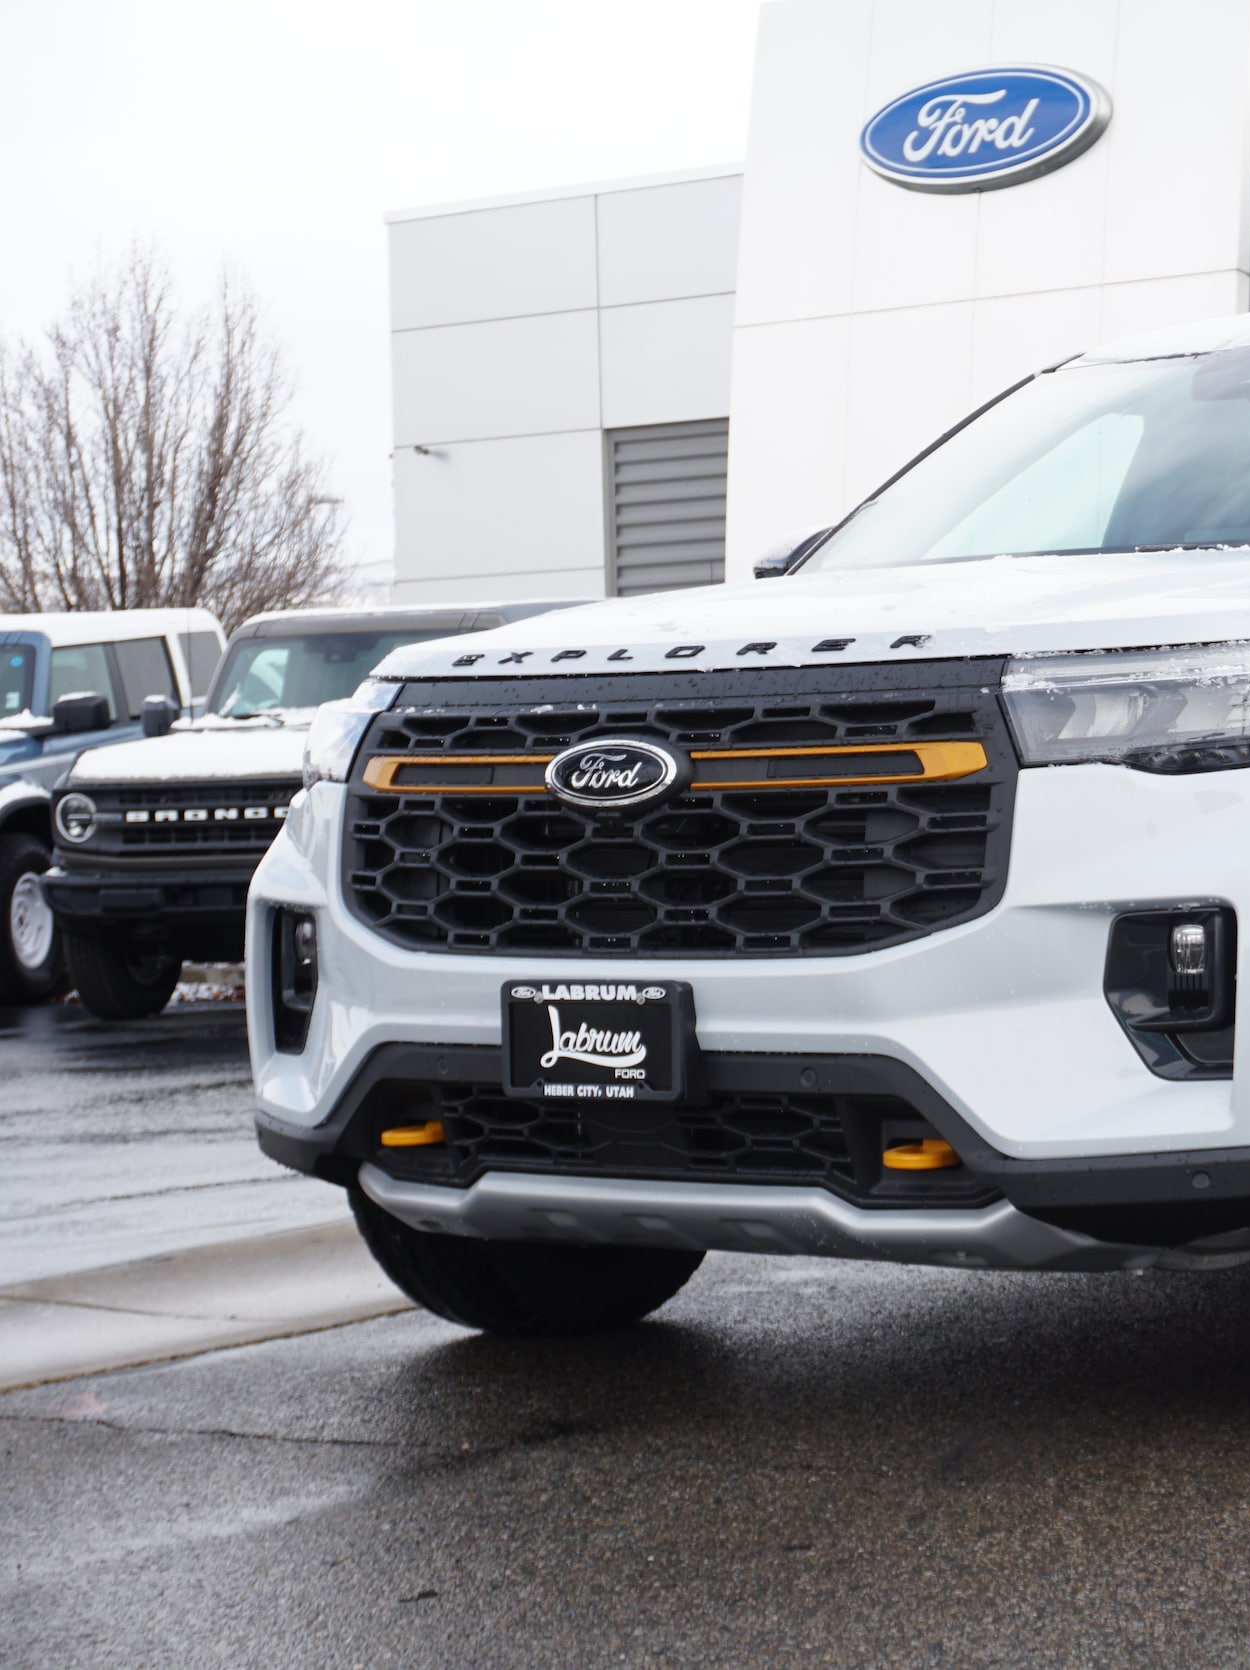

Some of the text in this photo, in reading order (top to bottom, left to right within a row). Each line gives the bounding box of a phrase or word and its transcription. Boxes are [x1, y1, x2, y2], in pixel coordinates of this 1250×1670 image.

[903, 88, 1039, 163] Ford
[452, 635, 934, 667] EXPLORER
[571, 752, 643, 790] Ford
[541, 985, 637, 1000] LABRUM
[540, 1005, 646, 1068] Labrum
[614, 1069, 646, 1079] FORD
[543, 1085, 634, 1098] HEBER CITY, UTAH
